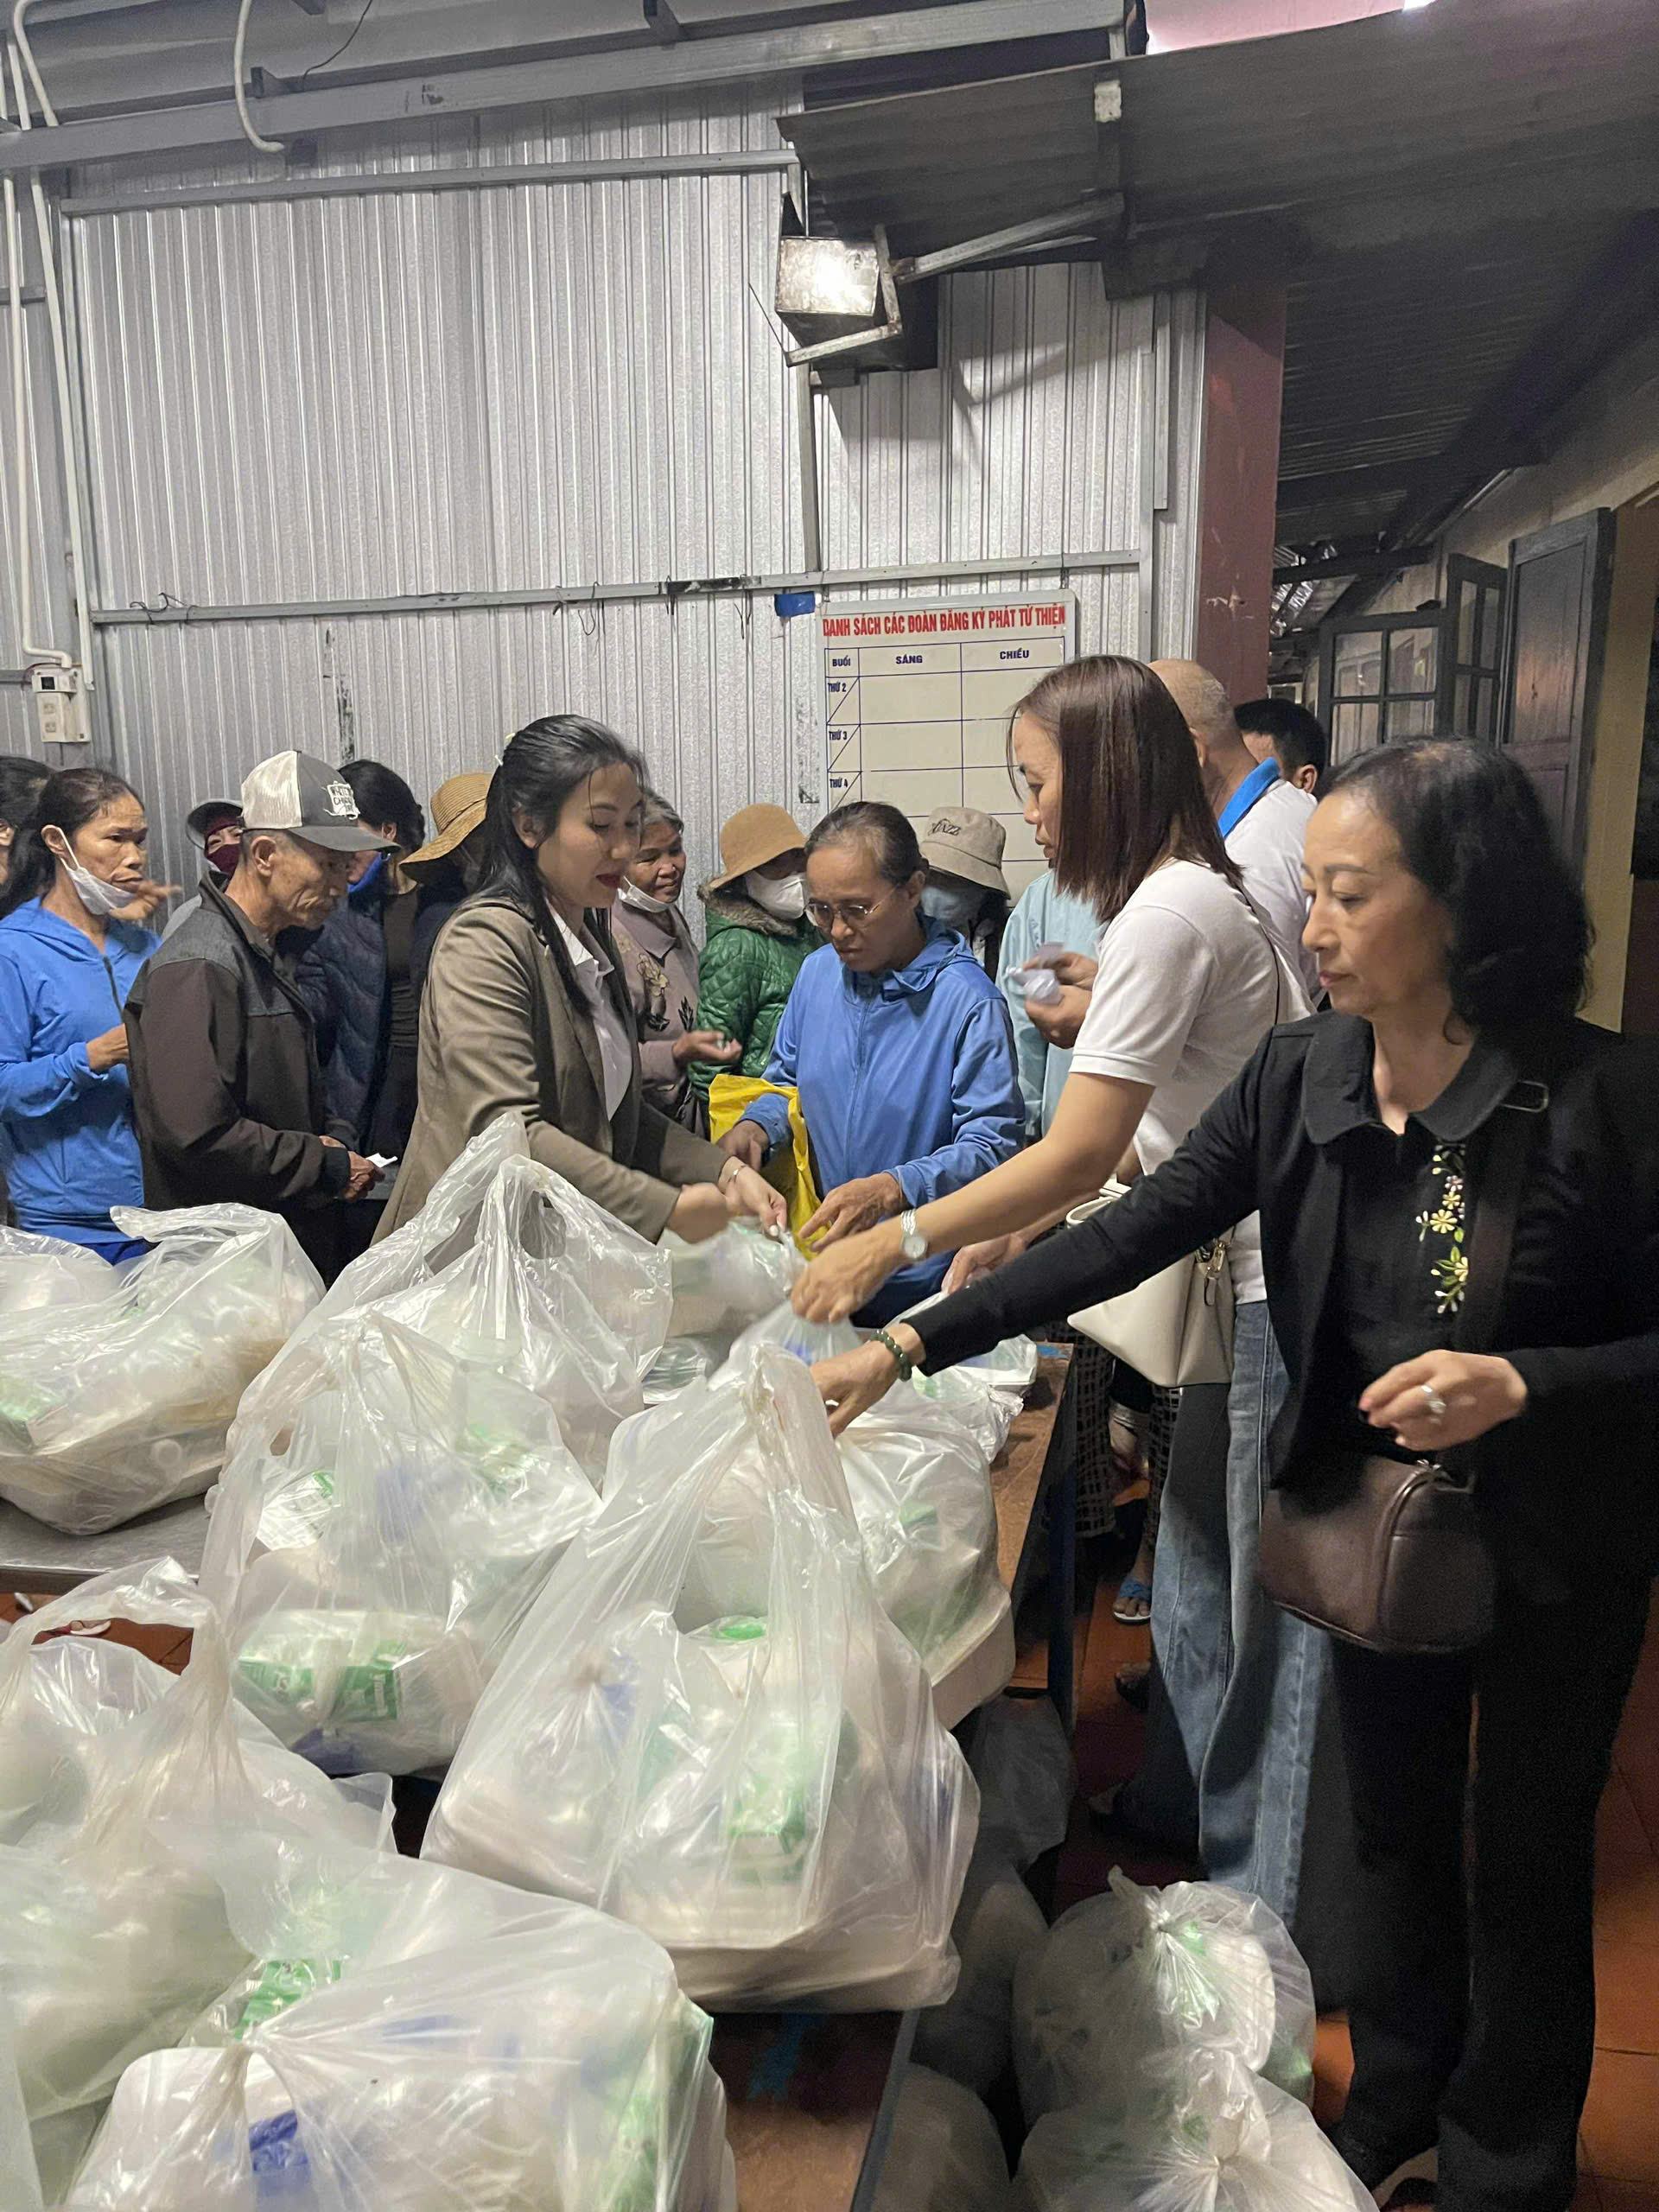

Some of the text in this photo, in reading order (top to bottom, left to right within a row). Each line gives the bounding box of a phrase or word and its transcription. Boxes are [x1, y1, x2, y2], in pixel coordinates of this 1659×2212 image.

[823, 602, 1065, 637] DANH SÁCH CÁC ĐOÀN ĐĂNG KÝ PHÁT TỪ THIỆN
[895, 653, 923, 664] SÁNG
[842, 683, 847, 692] 2
[842, 731, 848, 741] 3
[843, 779, 849, 788] 4
